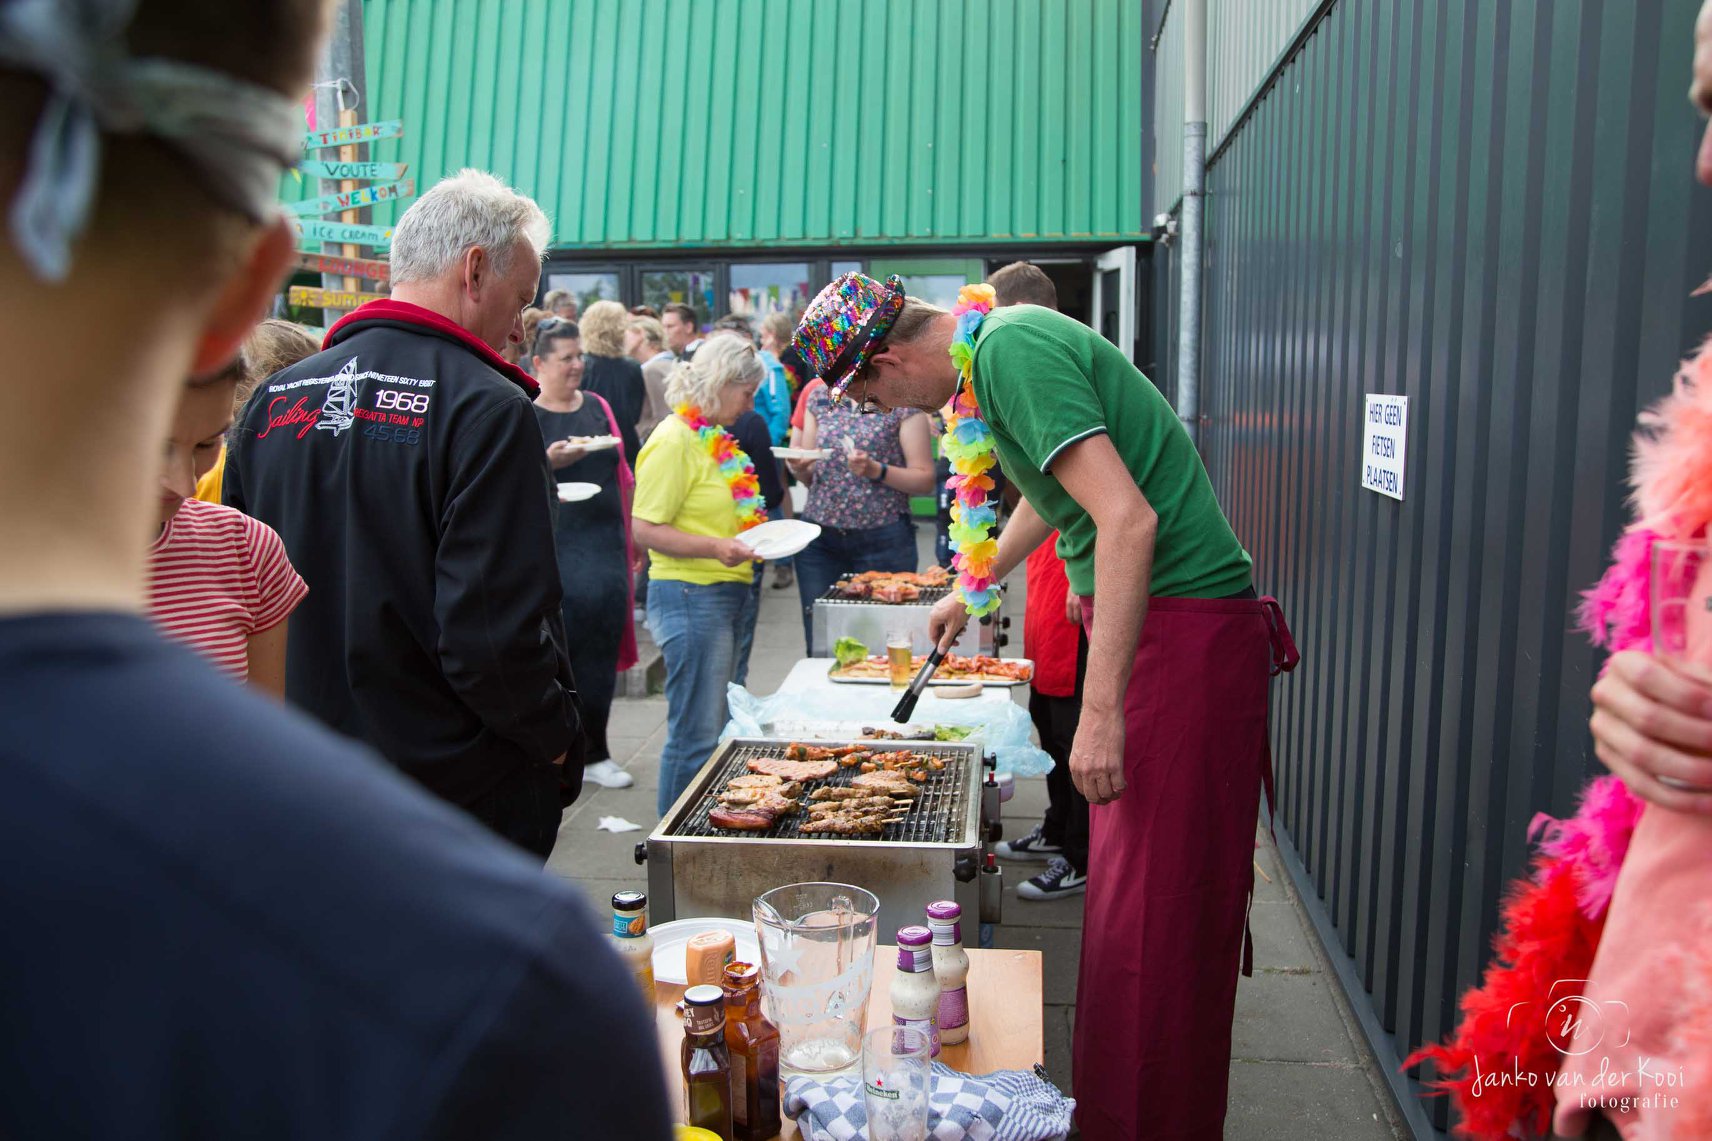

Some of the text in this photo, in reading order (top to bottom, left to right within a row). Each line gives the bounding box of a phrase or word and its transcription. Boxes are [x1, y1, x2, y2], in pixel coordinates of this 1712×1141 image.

[337, 184, 399, 208] WELKOM
[318, 257, 390, 280] LOUNGE
[369, 371, 398, 384] NINETEEN
[399, 376, 418, 386] SIXTY
[375, 389, 430, 414] 1968
[257, 396, 321, 440] Sailing
[354, 407, 425, 428] REGATTA TEAM NP
[1369, 403, 1402, 427] HIER GEEN
[1372, 434, 1396, 459] FIETSEN
[1366, 465, 1398, 493] PLAATSEN
